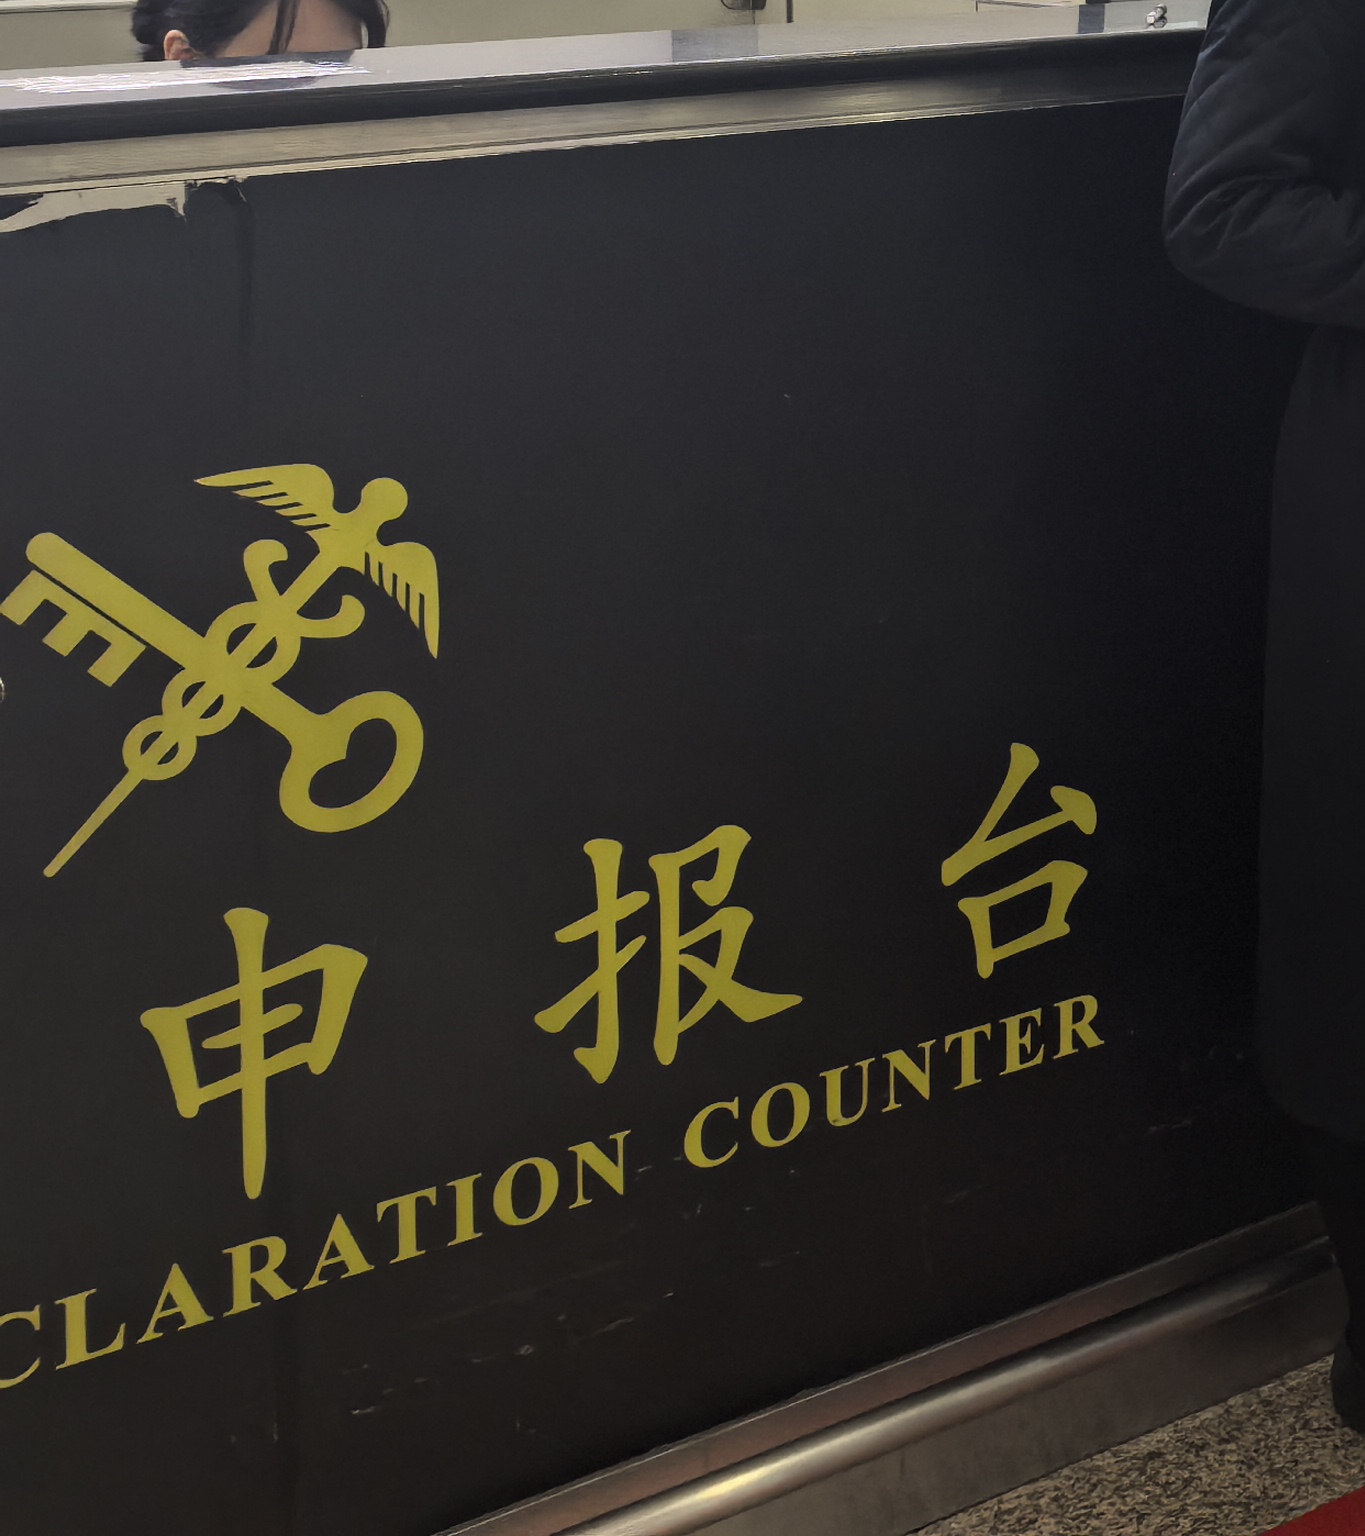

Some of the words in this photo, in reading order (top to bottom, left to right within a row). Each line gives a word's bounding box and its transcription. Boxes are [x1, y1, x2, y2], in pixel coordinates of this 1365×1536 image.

[140, 743, 1097, 1200] 申报台
[684, 995, 1105, 1168] COUNTER
